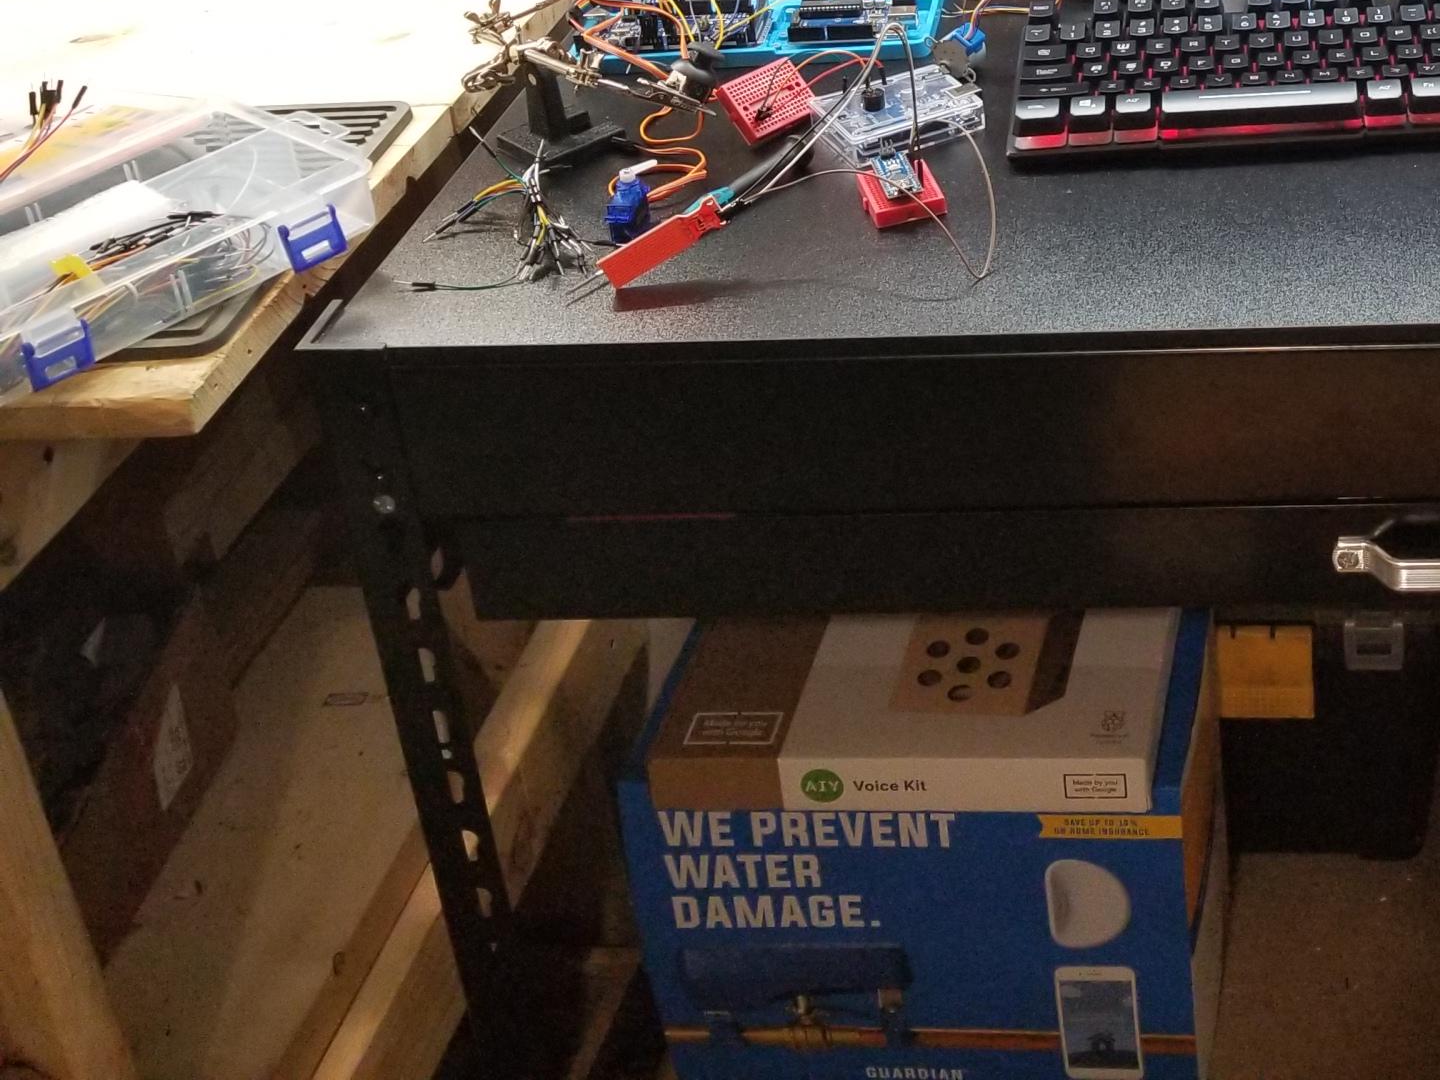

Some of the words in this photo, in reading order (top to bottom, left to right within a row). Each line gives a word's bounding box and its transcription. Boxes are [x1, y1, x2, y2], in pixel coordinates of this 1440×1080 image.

[805, 780, 840, 793] AIY
[852, 779, 900, 794] Voice
[904, 779, 928, 793] Kit
[1091, 786, 1118, 794] Google
[658, 811, 735, 847] WE
[750, 812, 956, 848] PREVENT
[664, 854, 822, 889] WATER
[671, 895, 881, 930] DAMAGE.
[865, 1067, 963, 1080] GUARDIAN
